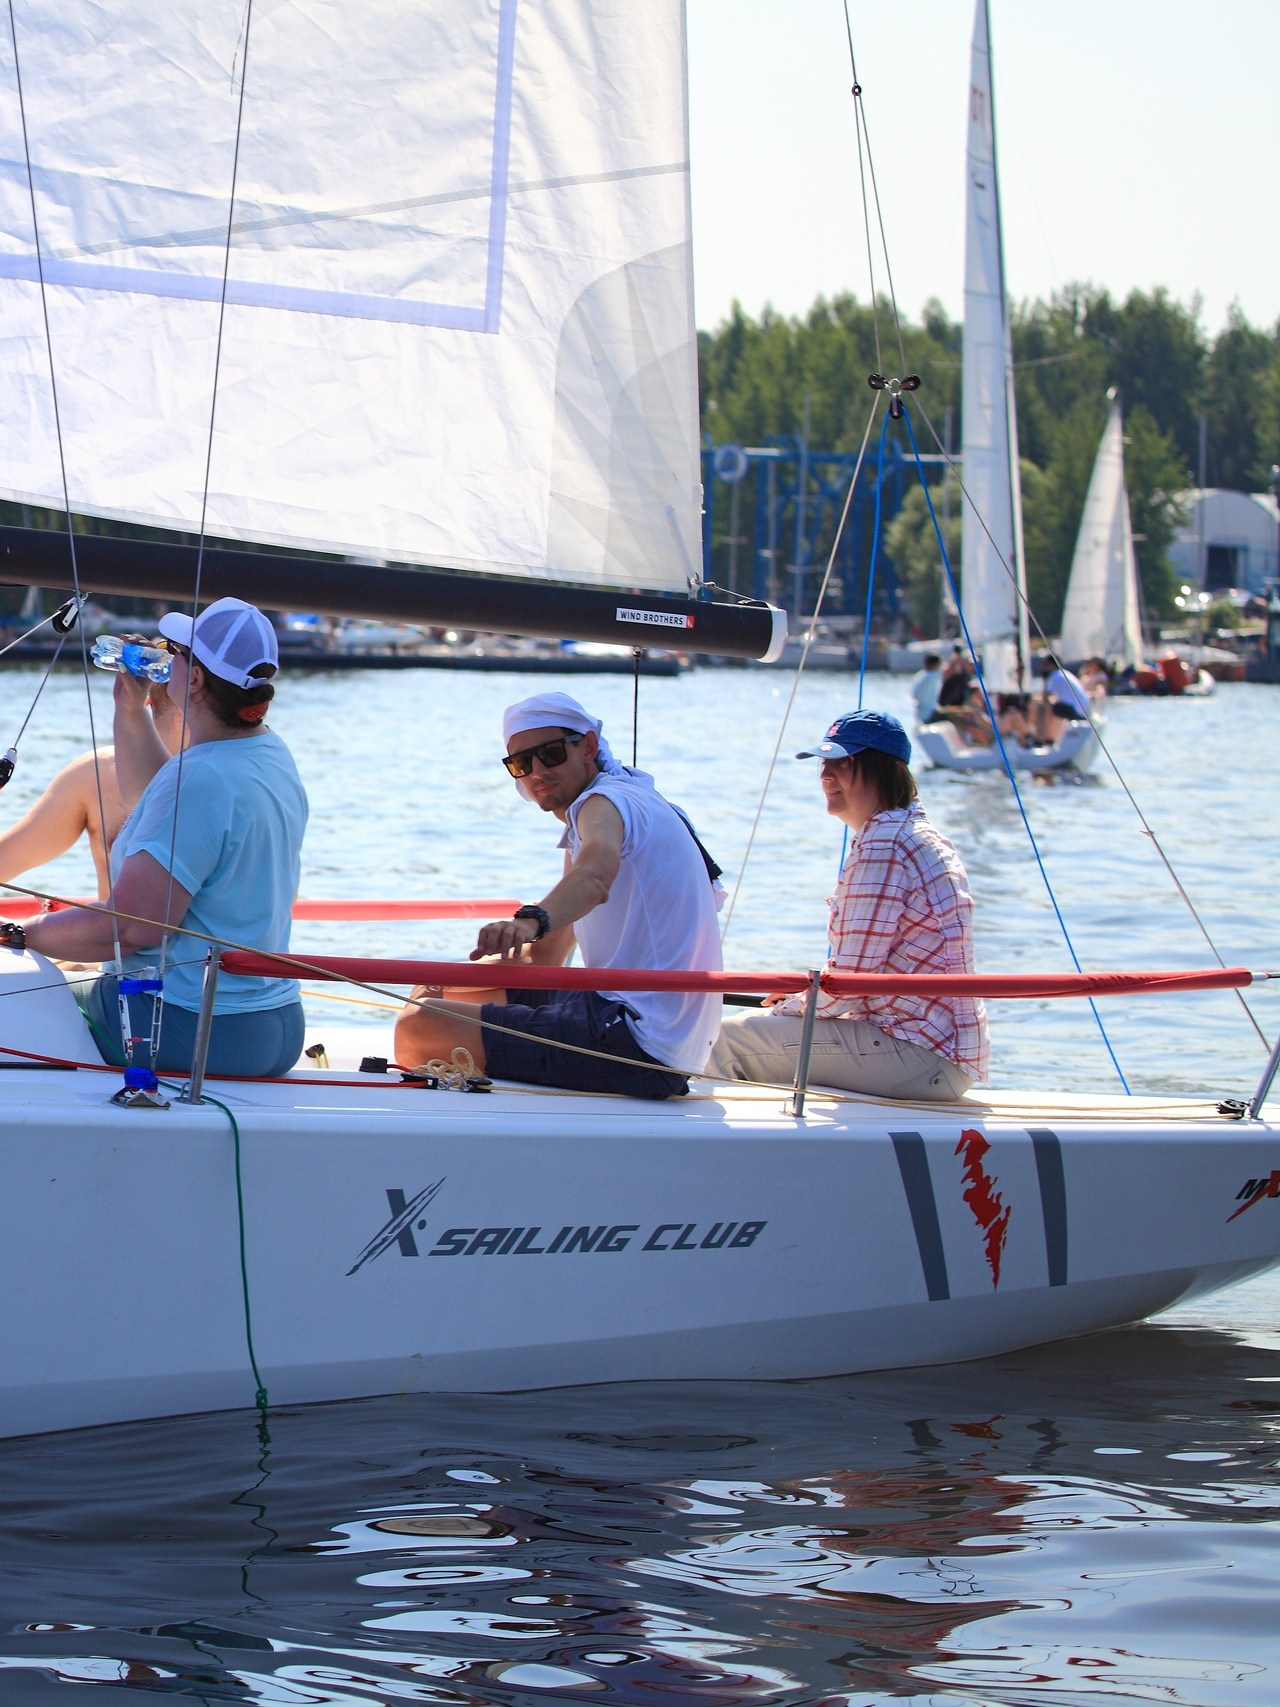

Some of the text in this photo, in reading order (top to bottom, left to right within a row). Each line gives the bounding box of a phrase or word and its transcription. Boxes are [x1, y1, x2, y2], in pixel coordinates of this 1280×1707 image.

[620, 611, 683, 625] WIND BROTHERS
[427, 1224, 640, 1257] SAILING
[641, 1220, 768, 1252] CLUB
